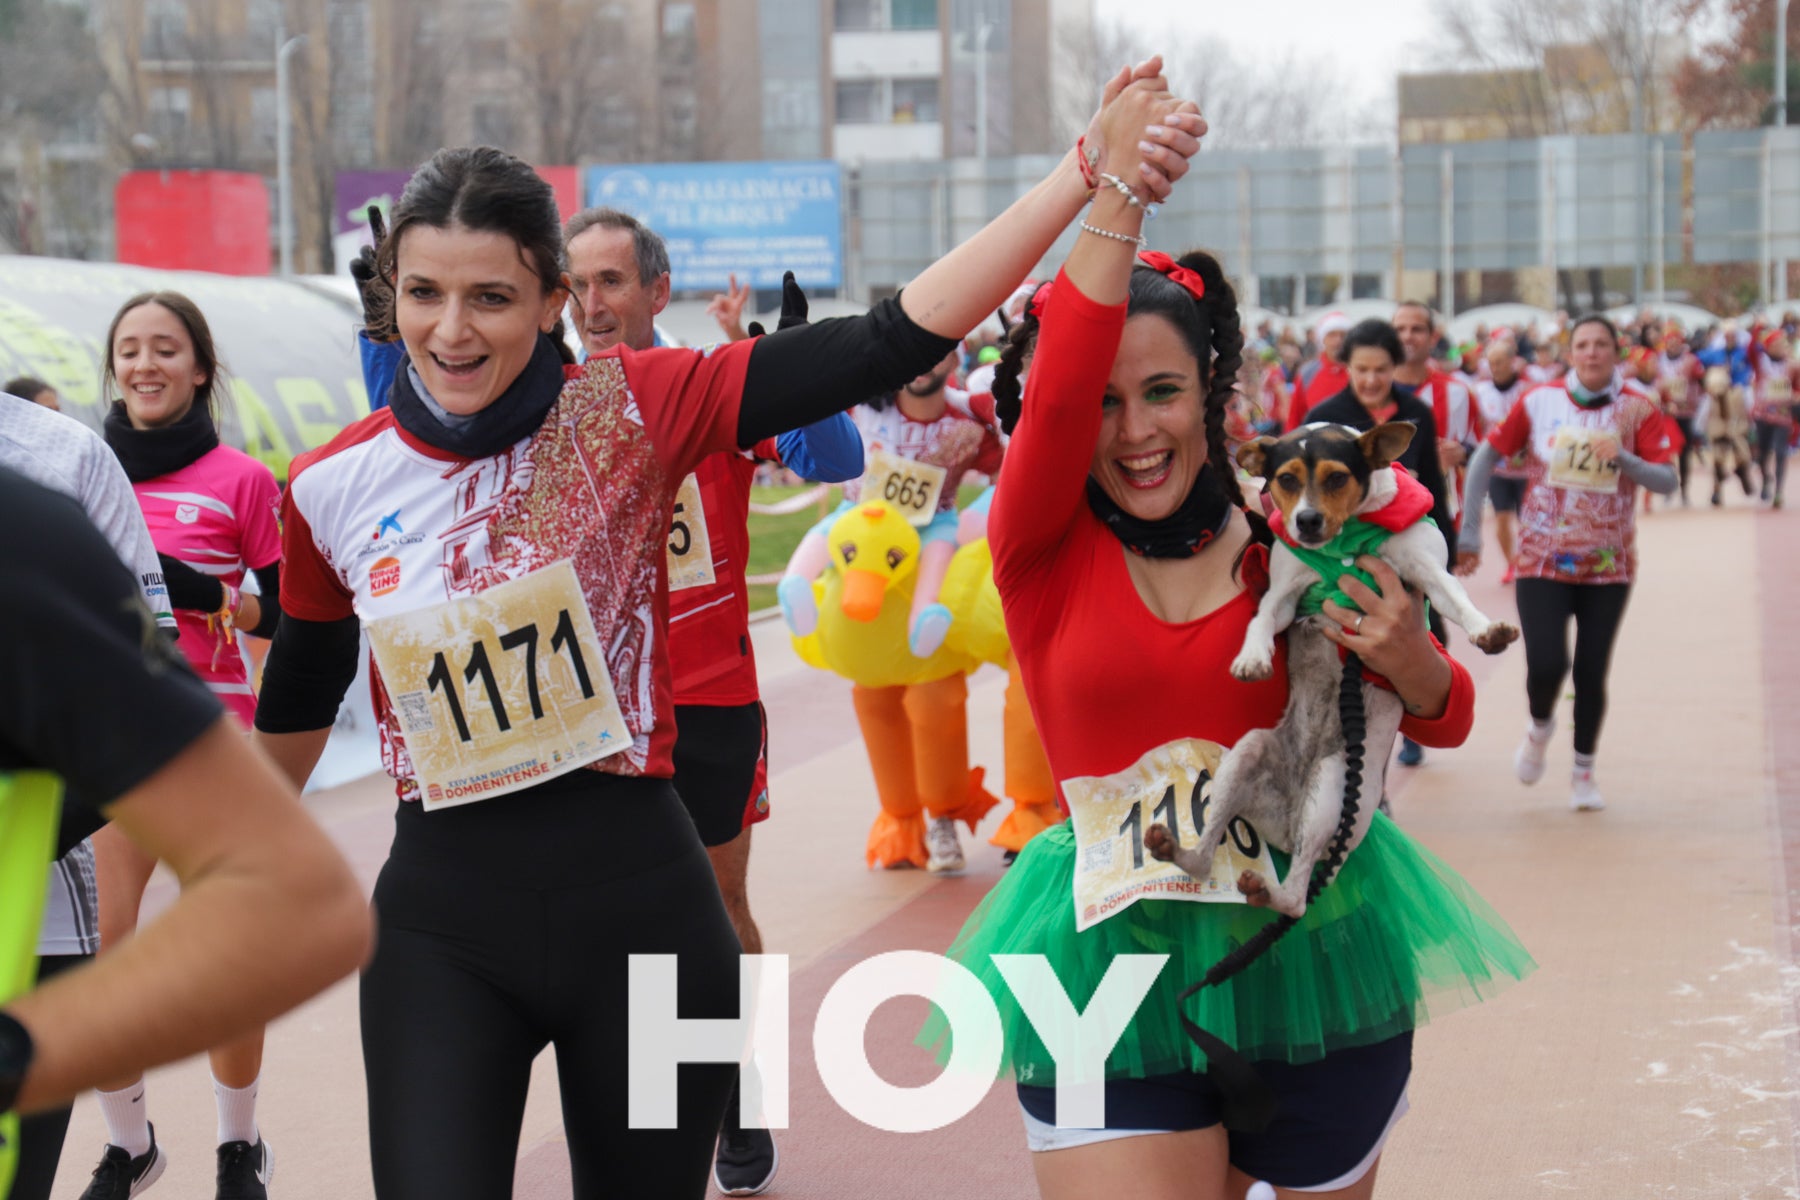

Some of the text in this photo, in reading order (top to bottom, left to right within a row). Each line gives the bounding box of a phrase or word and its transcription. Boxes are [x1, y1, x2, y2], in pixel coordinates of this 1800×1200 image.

[884, 472, 931, 510] 665
[370, 574, 400, 592] KING
[427, 608, 595, 743] 1171
[445, 762, 550, 799] DOMBENITENSE
[448, 776, 467, 788] XXIV
[469, 772, 488, 783] SAN
[490, 758, 539, 779] SILVESTRE
[1100, 881, 1201, 914] DOMBENITENSE
